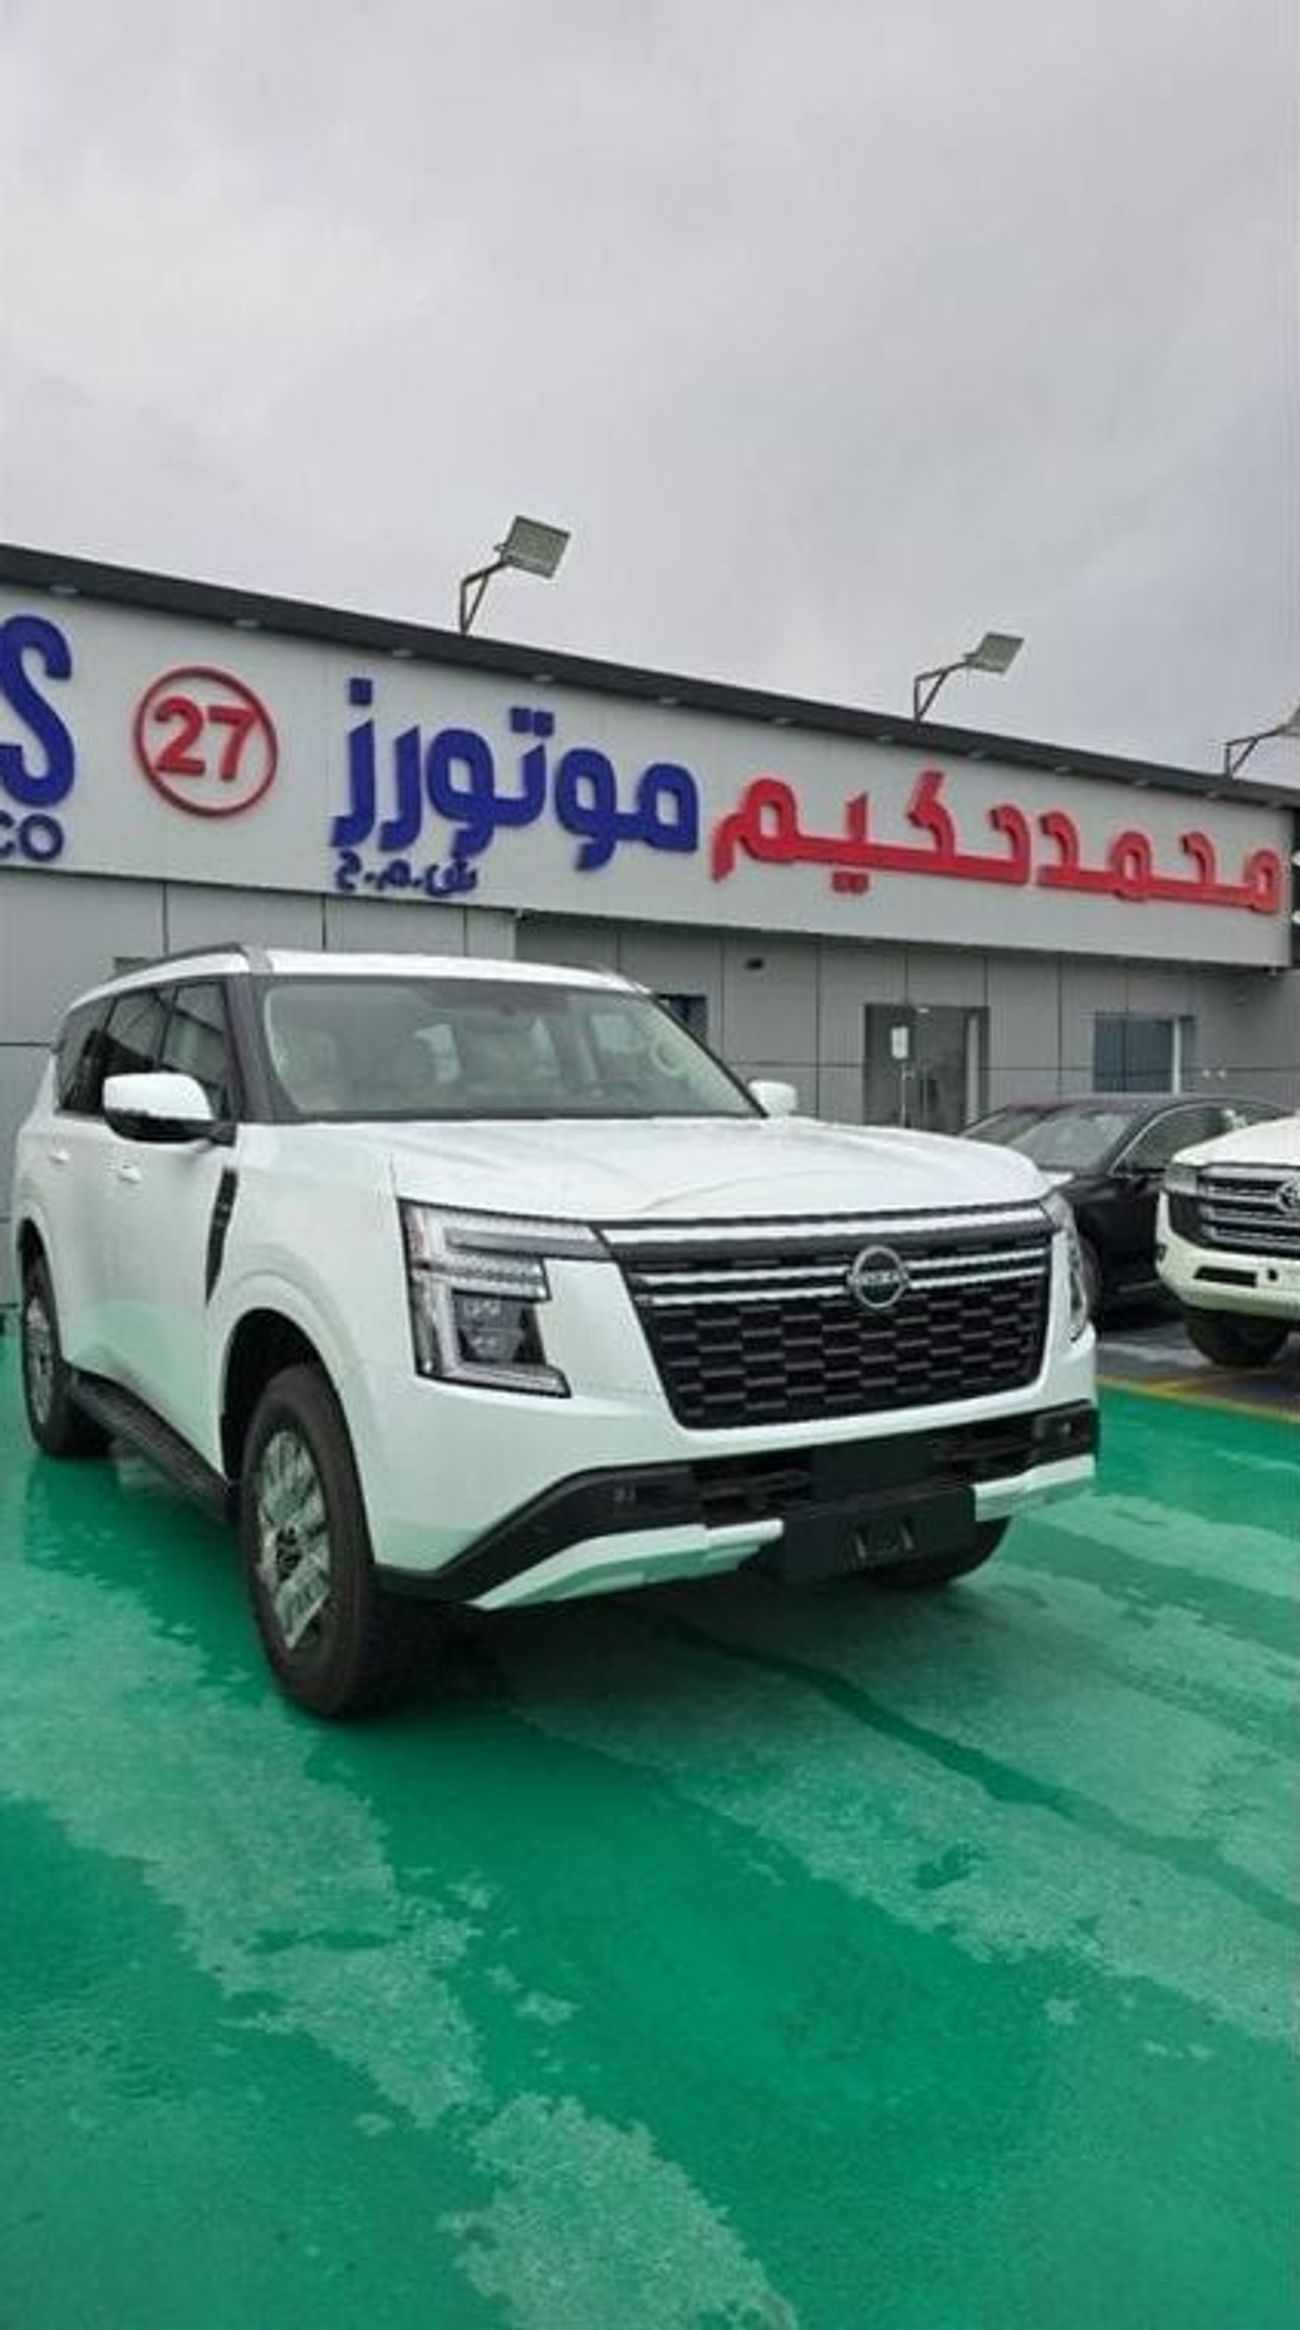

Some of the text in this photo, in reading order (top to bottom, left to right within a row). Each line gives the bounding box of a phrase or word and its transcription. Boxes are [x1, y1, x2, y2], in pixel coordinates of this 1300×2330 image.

[153, 696, 258, 782] 27
[331, 677, 1282, 914] محمد حكيم موتورز
